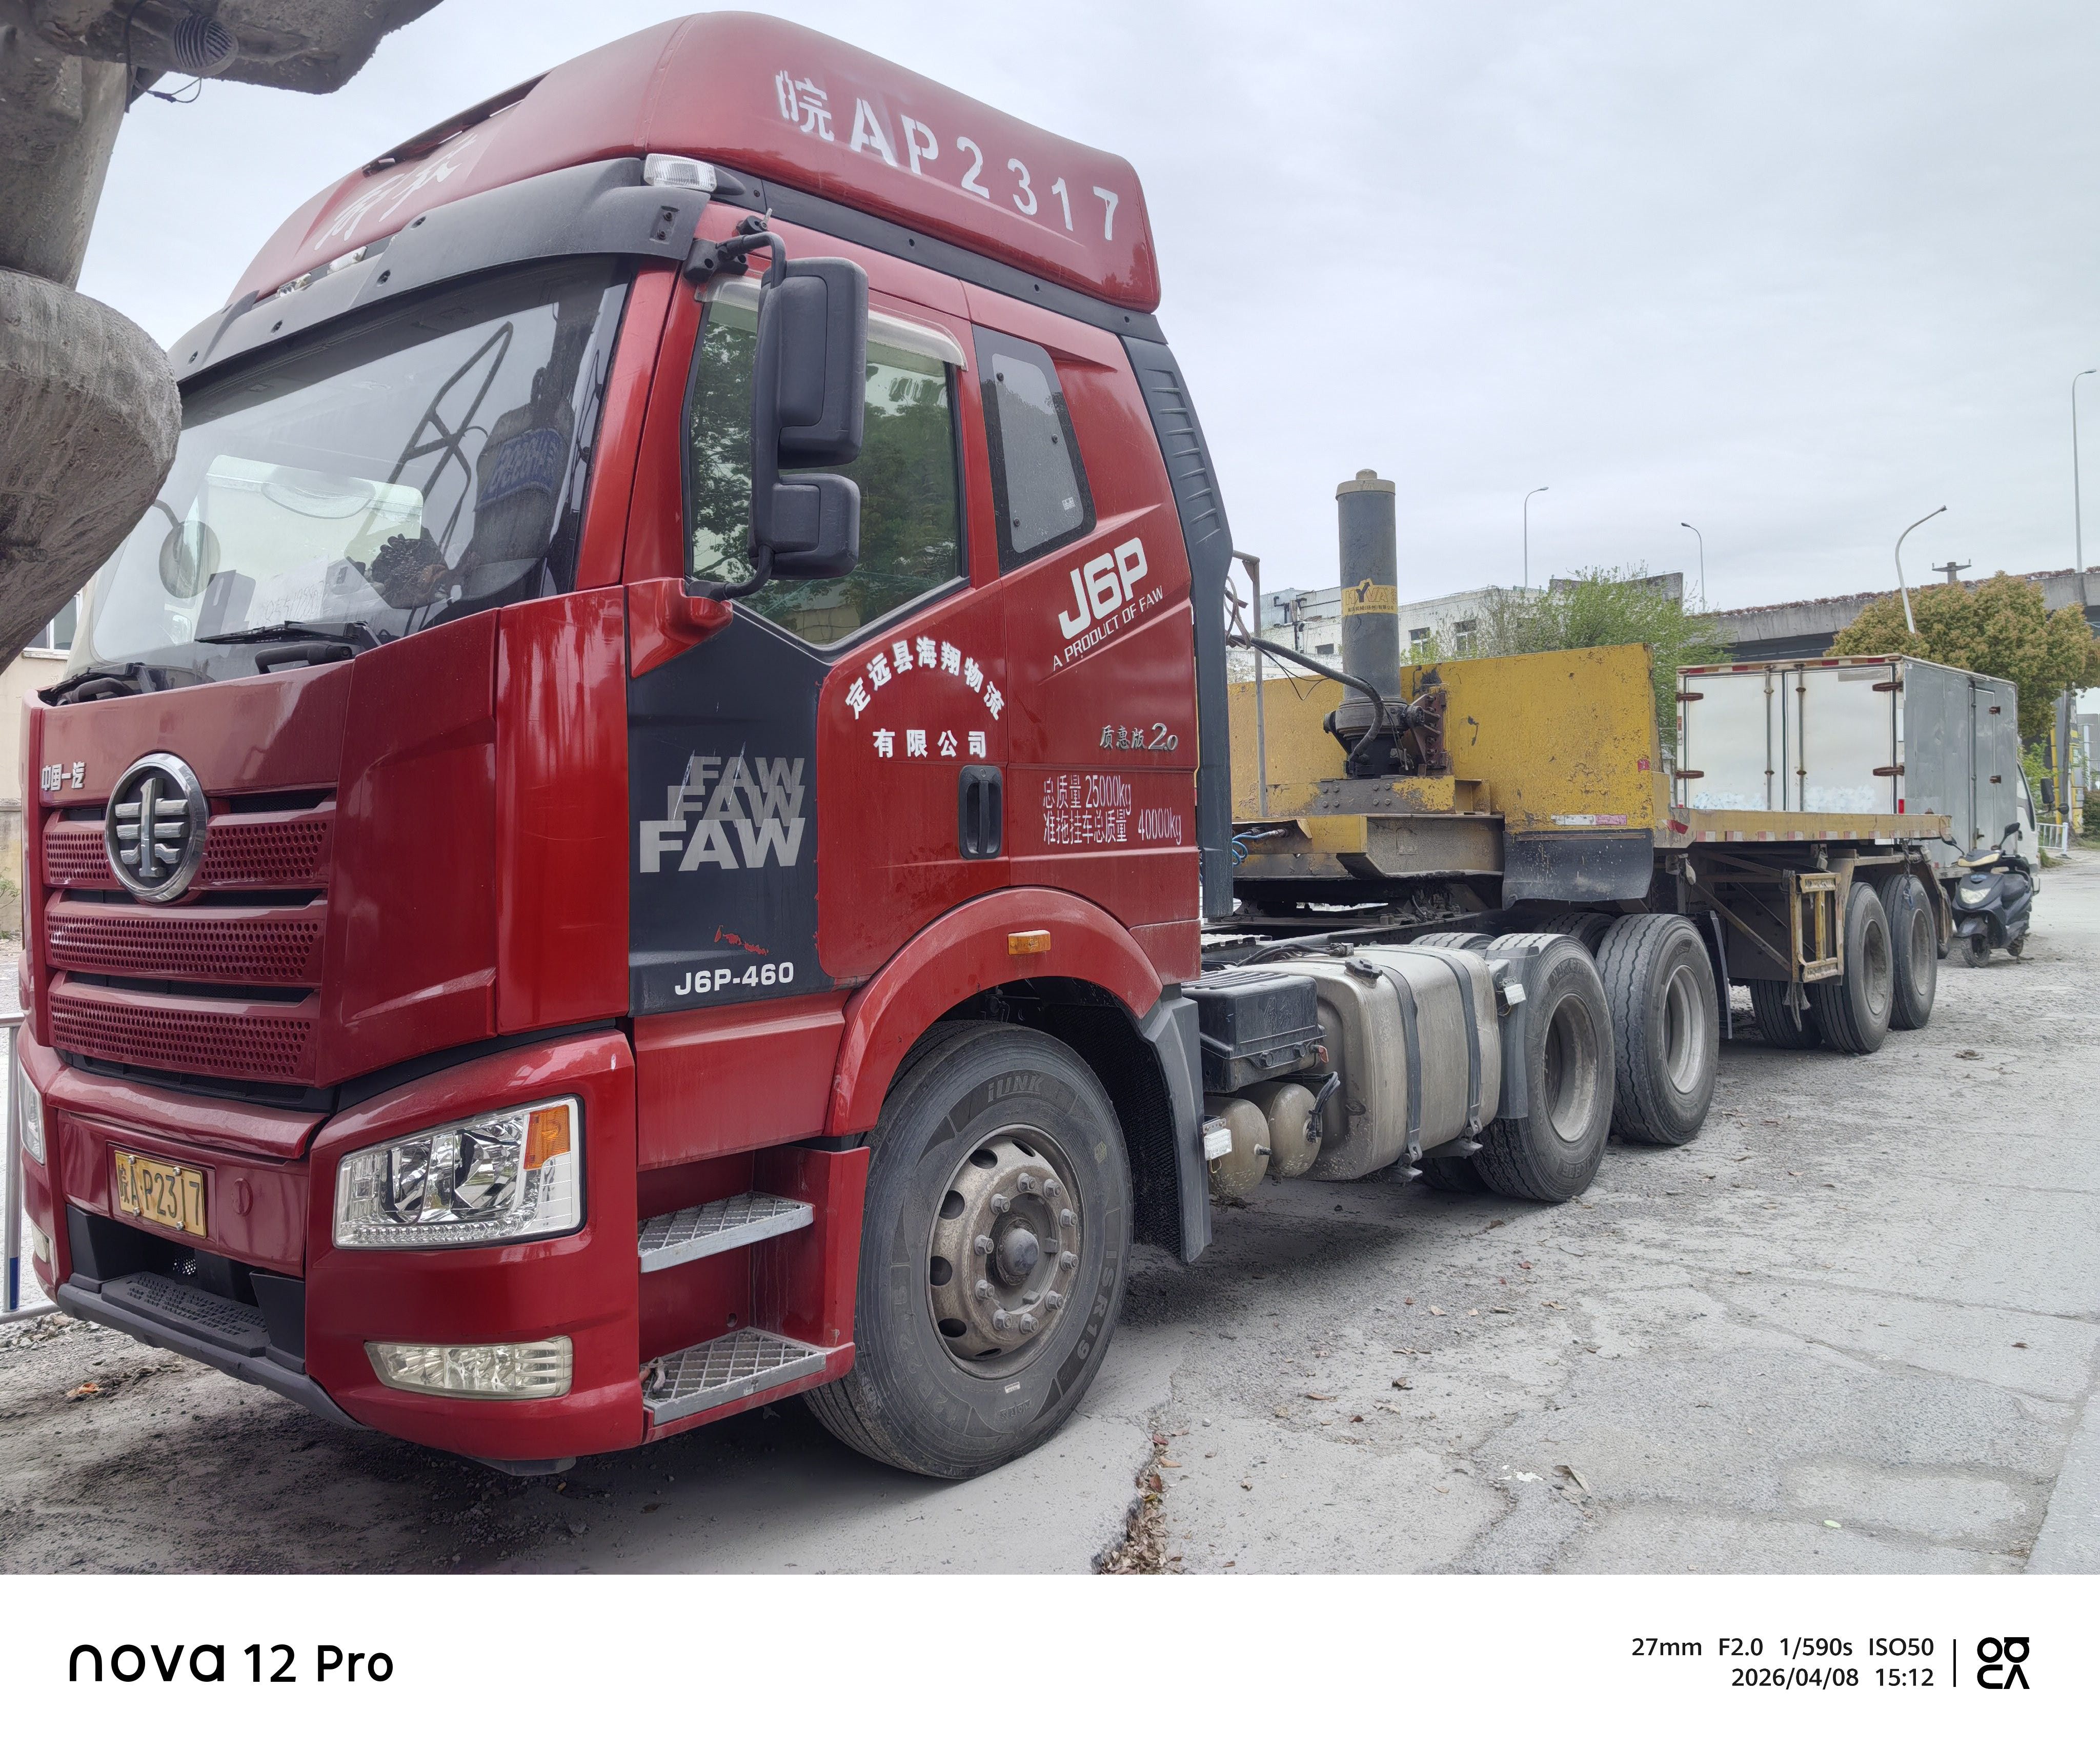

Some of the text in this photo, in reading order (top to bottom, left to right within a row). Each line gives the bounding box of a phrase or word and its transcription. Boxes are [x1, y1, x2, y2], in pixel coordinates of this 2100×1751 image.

[775, 70, 1119, 240] 皖AP2317
[1058, 537, 1148, 640] J6P
[1053, 585, 1163, 671] A PRODUCT OF FAW
[845, 636, 1004, 721] 定远县海翔物流
[873, 728, 986, 758] 有限公司
[41, 761, 86, 791] 中国一汽
[690, 756, 805, 793] FAW
[667, 785, 805, 827] FAW
[1043, 807, 1182, 845] 准拖挂车总质量 40000kg
[640, 817, 806, 873] FAW
[675, 962, 794, 995] J6P-460
